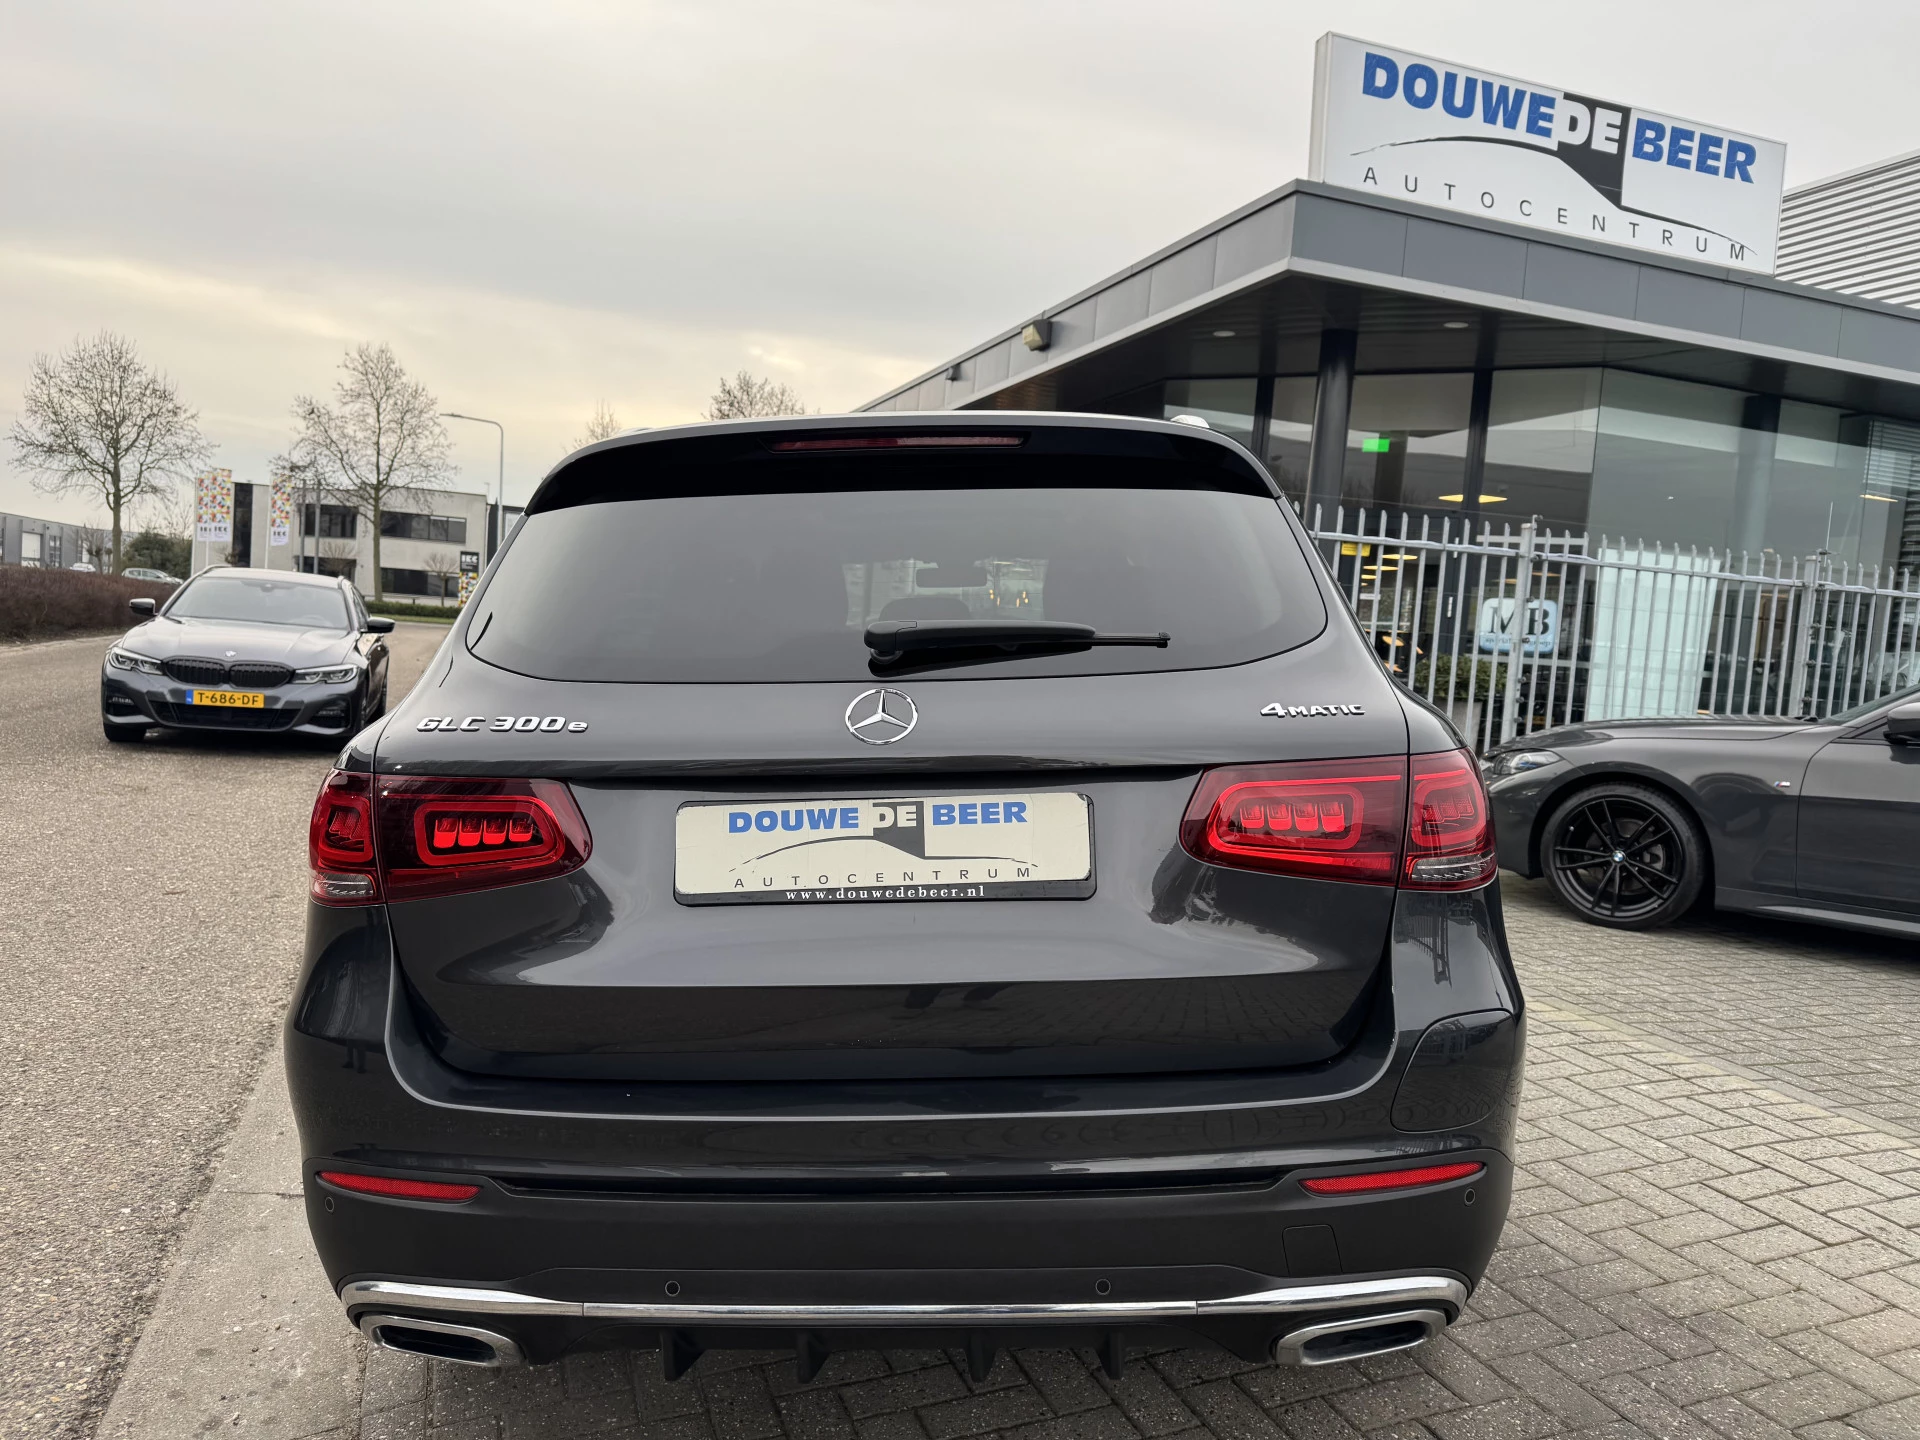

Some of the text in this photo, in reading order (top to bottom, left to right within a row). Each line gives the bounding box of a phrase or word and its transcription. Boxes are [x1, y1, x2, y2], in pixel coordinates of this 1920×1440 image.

[1362, 52, 1757, 184] DOUWE DE BEER
[1363, 166, 1746, 262] AUTOCENTRUM
[198, 692, 259, 706] T-686-DF
[1260, 702, 1366, 718] 4MATIC
[416, 716, 486, 732] GLC
[728, 801, 1028, 834] DOUWE DE BEER
[734, 866, 1031, 889] AUTOCENTRUM
[785, 885, 986, 901] www.douwedebeer.nl
